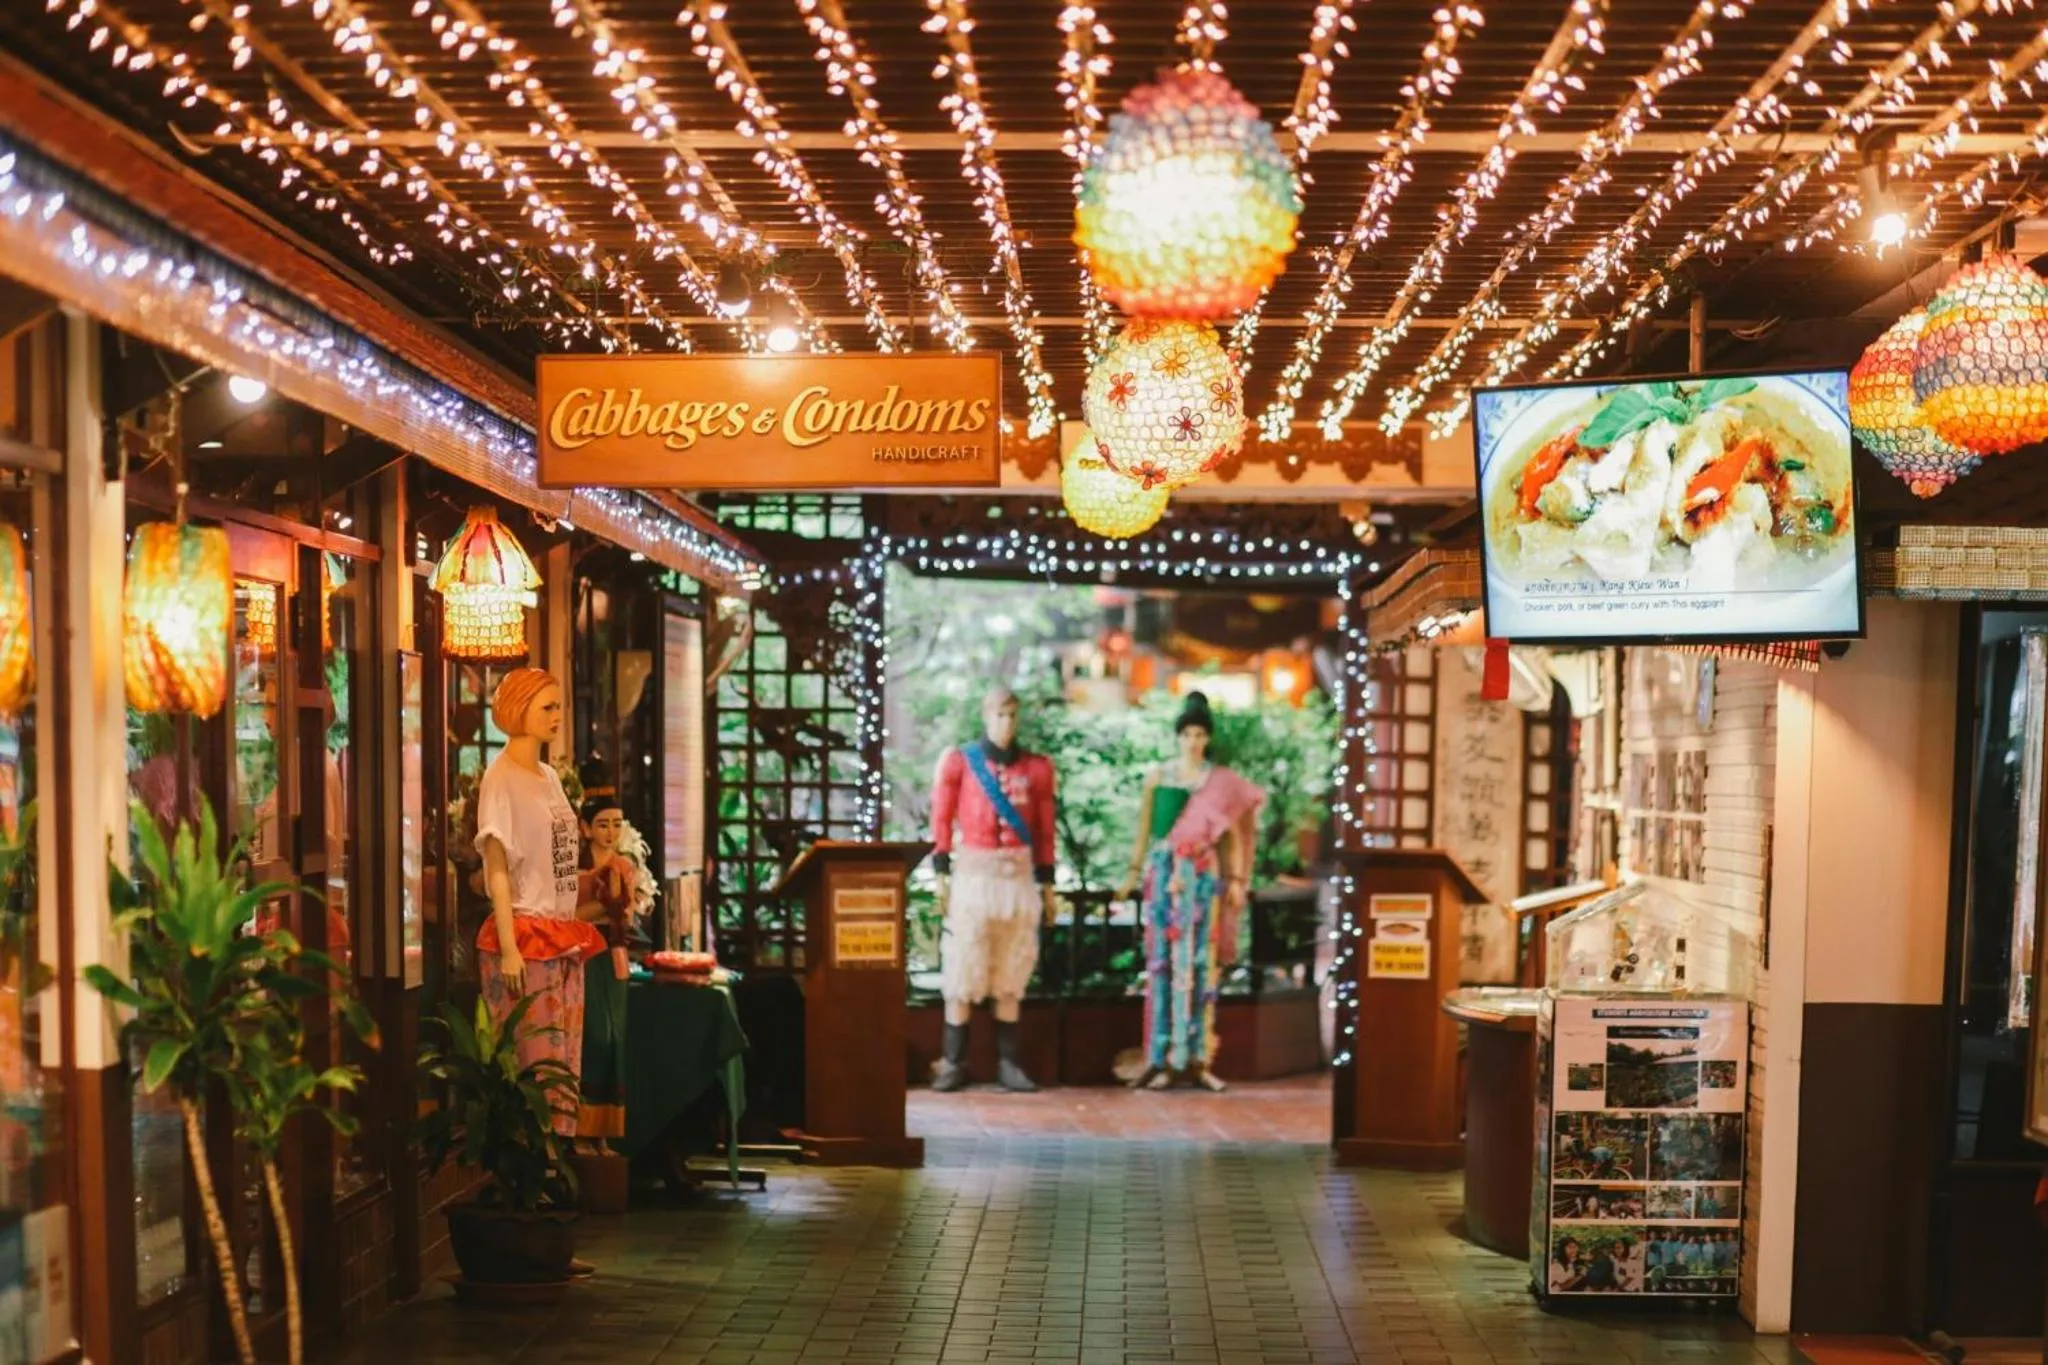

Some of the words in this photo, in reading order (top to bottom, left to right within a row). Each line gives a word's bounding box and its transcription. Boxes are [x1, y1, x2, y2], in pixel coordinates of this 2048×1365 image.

[550, 387, 750, 450] Cabbages
[752, 409, 776, 435] &
[782, 385, 990, 447] Condoms
[872, 445, 981, 461] HANDICRAFT
